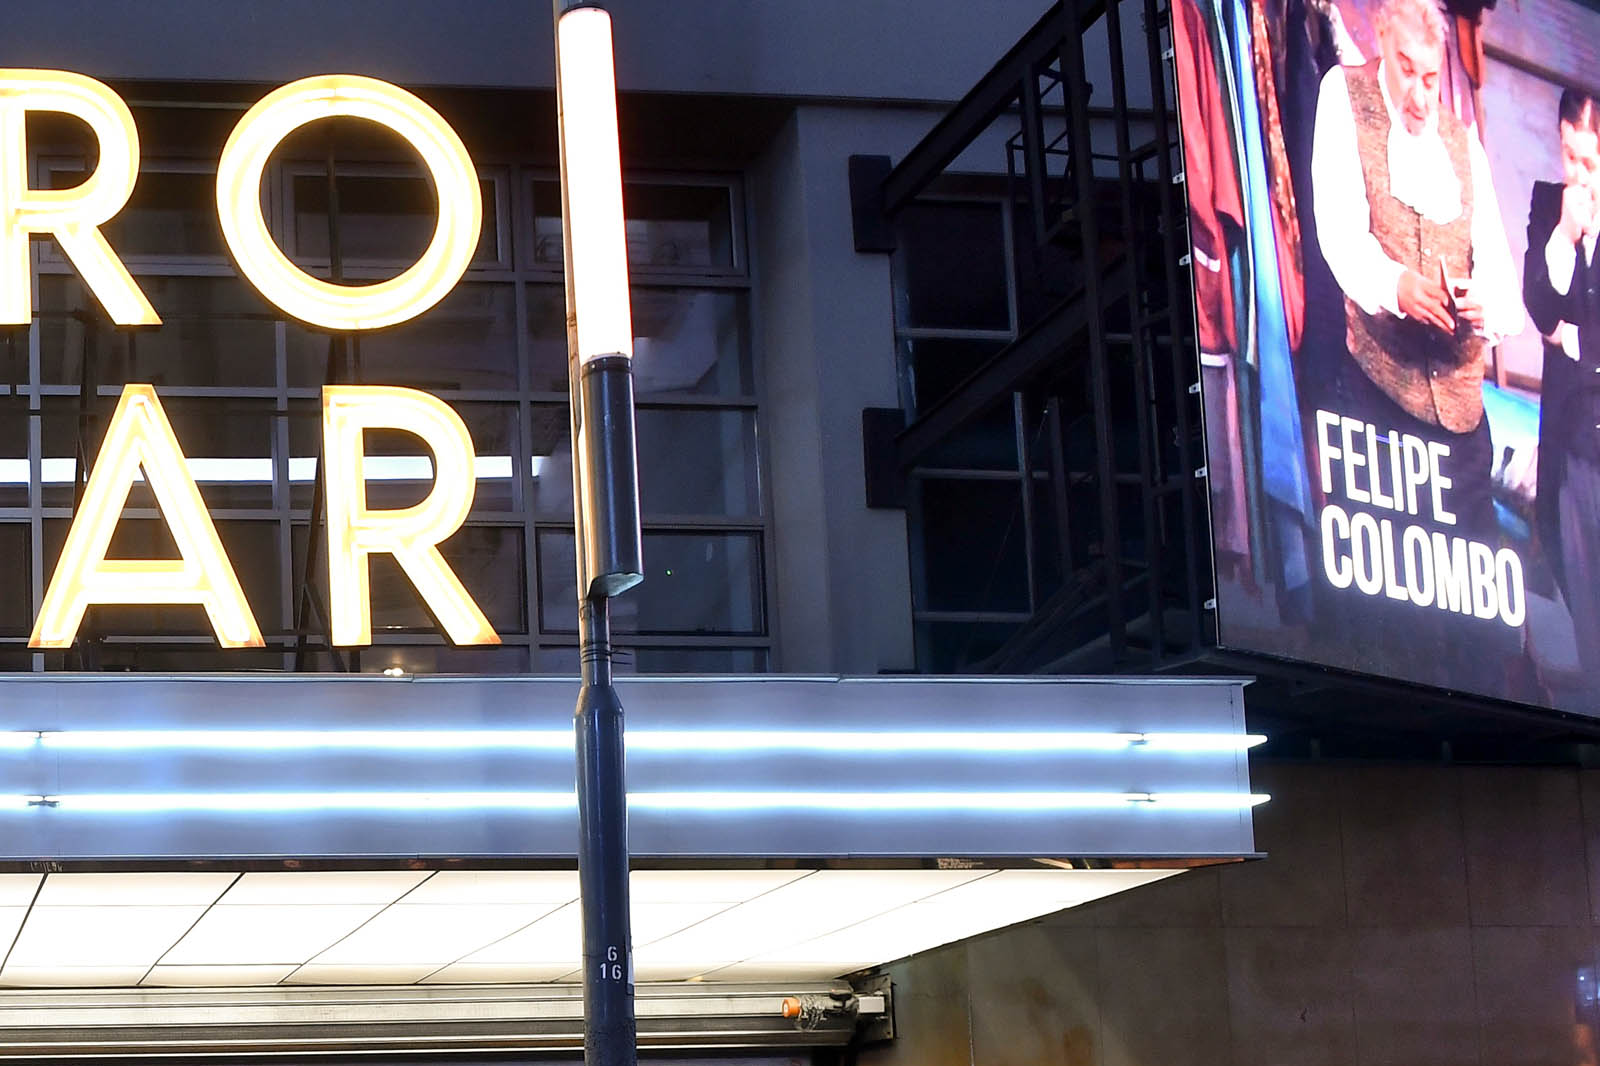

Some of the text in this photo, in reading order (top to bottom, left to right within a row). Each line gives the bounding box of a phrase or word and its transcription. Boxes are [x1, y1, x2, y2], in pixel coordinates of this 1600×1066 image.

[1315, 409, 1457, 525] FELIPE
[1320, 504, 1527, 628] COLOMBO
[600, 963, 622, 980] 16
[607, 946, 618, 961] 6
